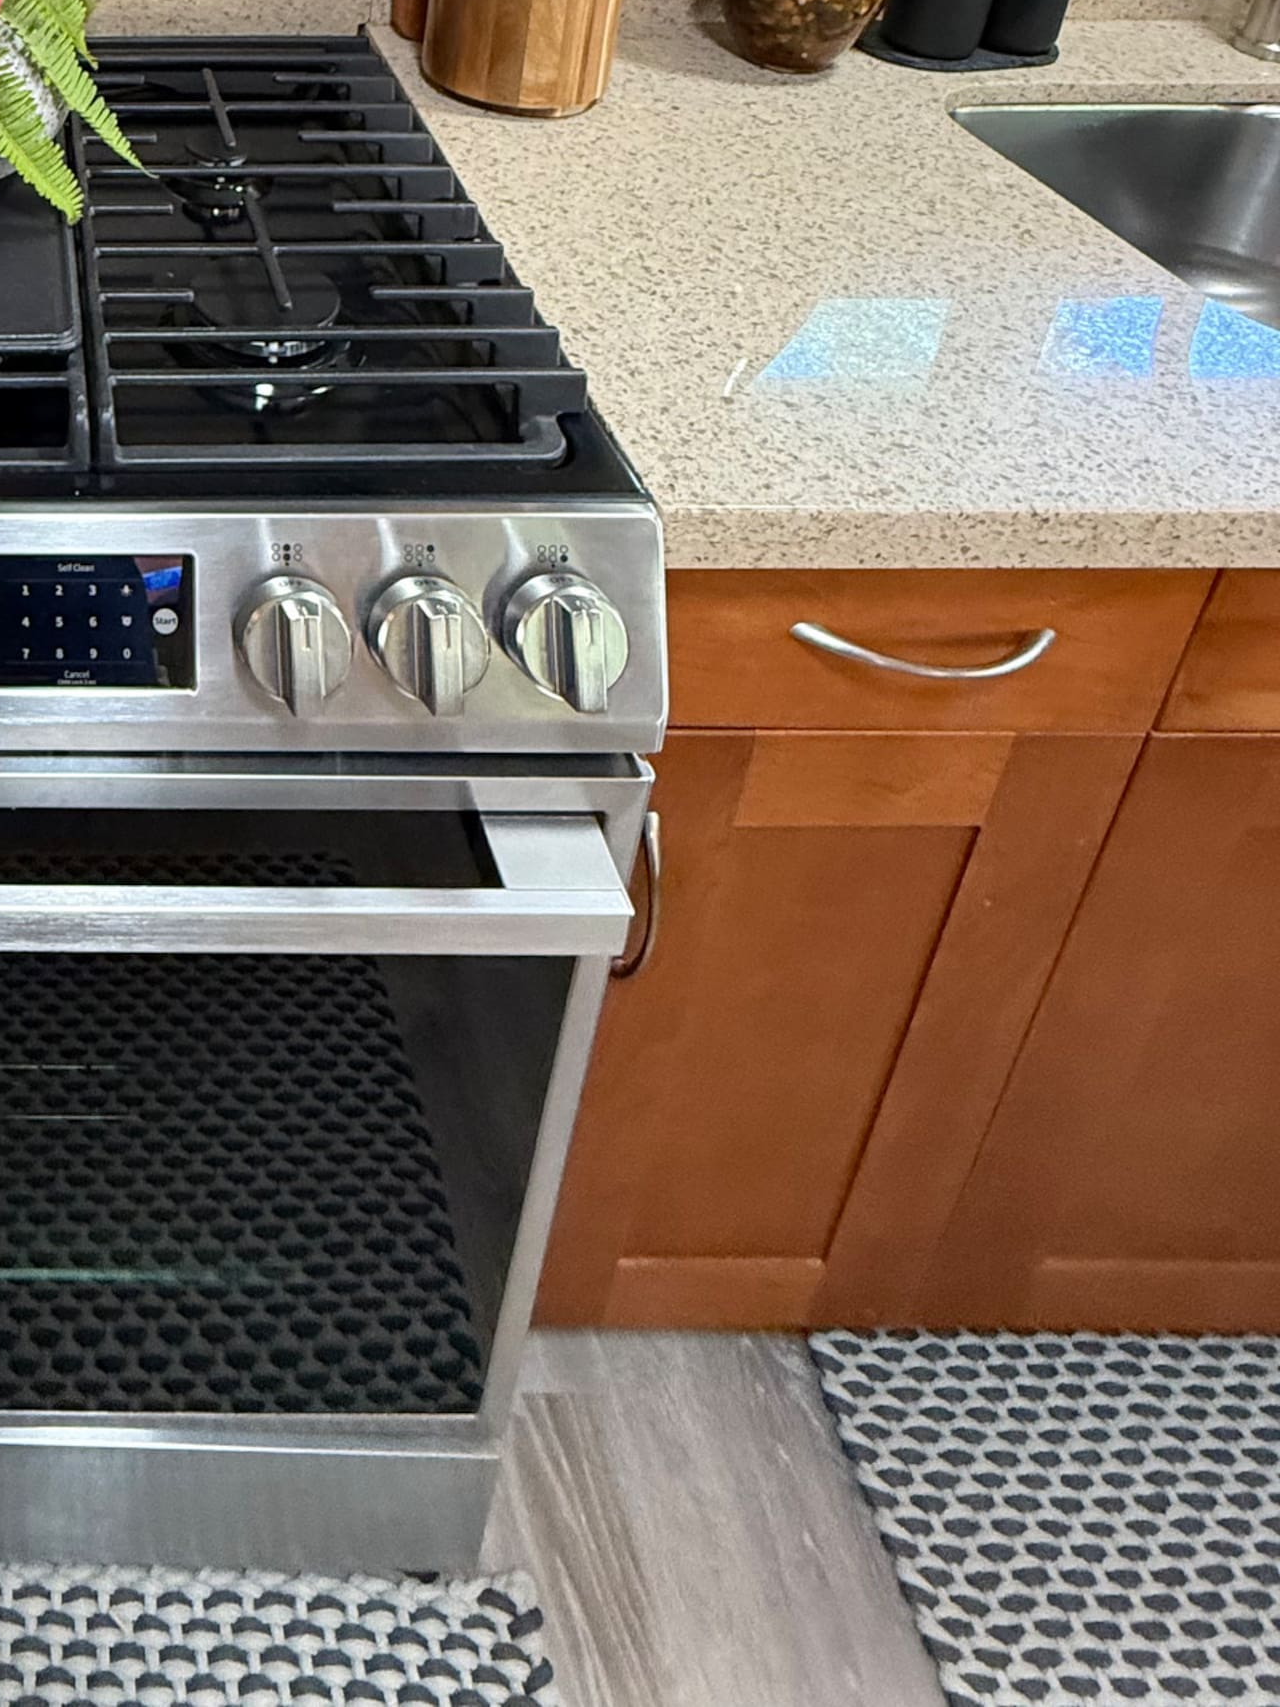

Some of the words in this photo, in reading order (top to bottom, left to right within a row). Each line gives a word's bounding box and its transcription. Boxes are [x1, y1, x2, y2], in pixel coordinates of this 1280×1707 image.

[57, 564, 73, 572] Self
[73, 564, 94, 572] Clean
[22, 585, 30, 596] 1
[55, 585, 63, 595] 2
[88, 585, 97, 595] 3
[21, 617, 30, 627] 4
[55, 617, 64, 627] 5
[88, 617, 98, 627] 6
[154, 616, 176, 626] Start
[22, 648, 30, 659] 7
[55, 648, 64, 659] 8
[89, 648, 98, 659] 9
[122, 648, 132, 659] 0
[64, 670, 90, 678] Cancel
